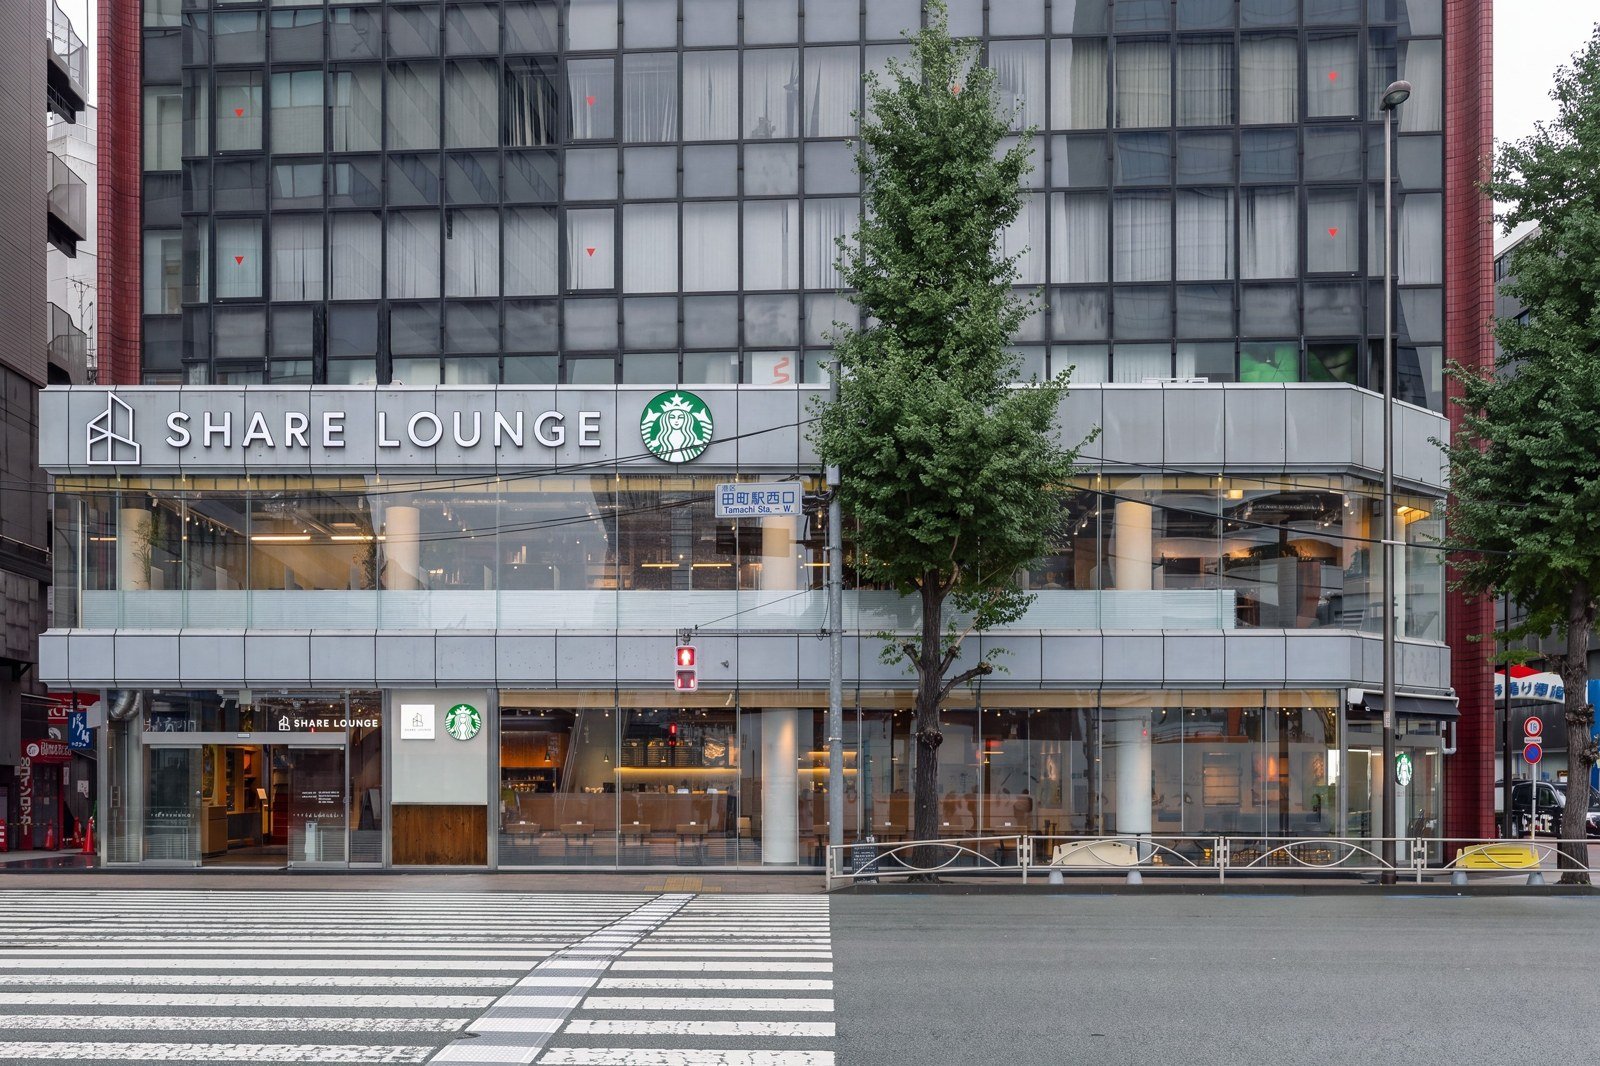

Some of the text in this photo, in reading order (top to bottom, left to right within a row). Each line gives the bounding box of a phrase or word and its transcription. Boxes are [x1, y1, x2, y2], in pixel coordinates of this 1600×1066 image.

[165, 410, 601, 448] SHARE LOUNGE
[722, 491, 795, 505] 田町駅西口
[724, 505, 756, 514] Tamachi
[294, 719, 379, 728] SHARE LOUNGE
